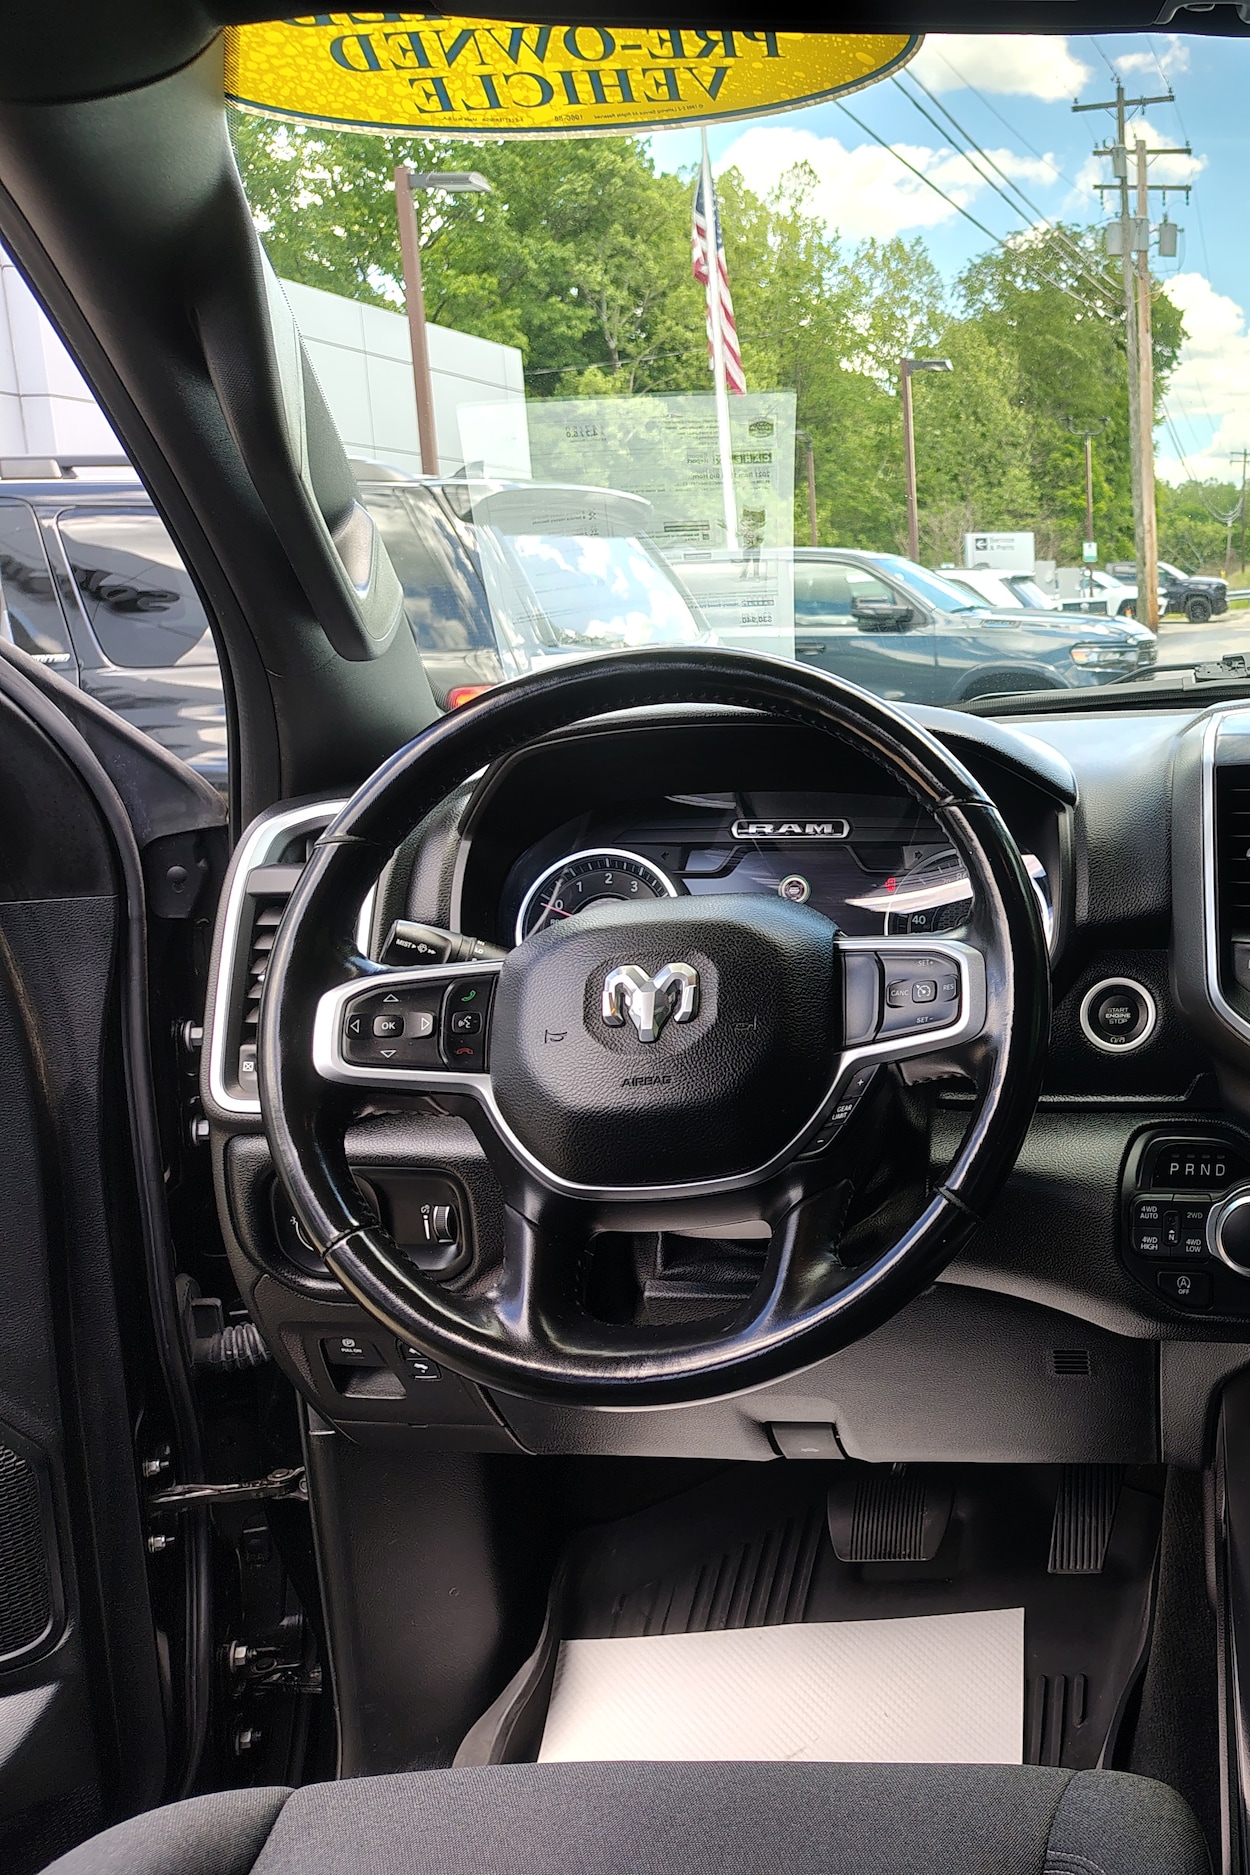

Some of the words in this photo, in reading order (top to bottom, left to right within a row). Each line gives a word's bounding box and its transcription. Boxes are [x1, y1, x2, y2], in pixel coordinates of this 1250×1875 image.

[748, 823, 835, 834] RAM
[604, 872, 613, 884] 2
[575, 881, 583, 892] 1
[630, 881, 638, 892] 3
[554, 899, 564, 910] 0
[911, 914, 926, 925] 40
[395, 938, 412, 949] MIST
[942, 983, 954, 991] RES
[890, 989, 910, 997] CANC
[380, 1021, 396, 1030] OK
[620, 1075, 672, 1088] AIRBAG
[836, 1104, 853, 1113] GEAR
[831, 1111, 848, 1121] LIMIT
[1169, 1163, 1180, 1175] P
[1185, 1163, 1195, 1176] R
[1200, 1163, 1211, 1176] N
[1215, 1164, 1225, 1177] D
[1139, 1212, 1159, 1220] AUTO
[1141, 1236, 1158, 1244] 4WD
[1185, 1238, 1202, 1246] 4WD
[1140, 1243, 1158, 1251] HIGH
[1185, 1245, 1202, 1253] LOW
[1178, 1287, 1190, 1295] OFF
